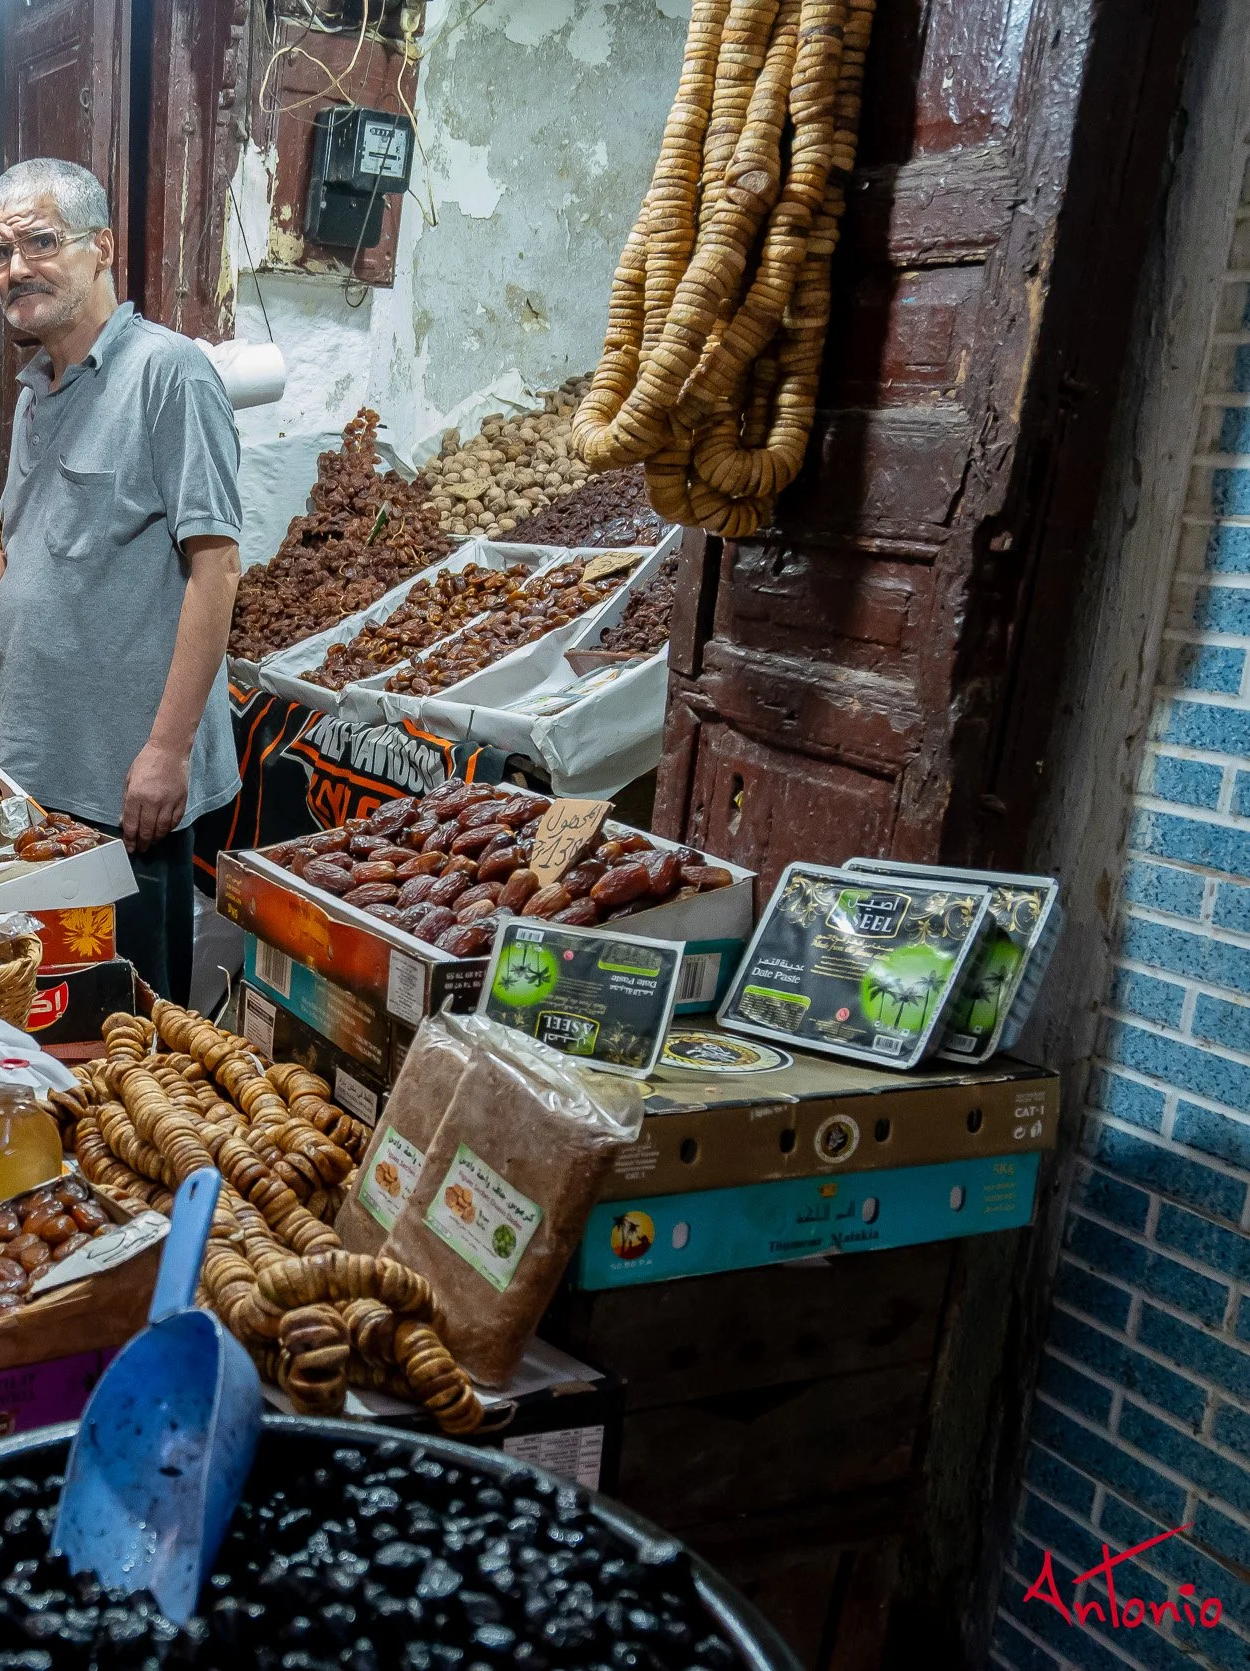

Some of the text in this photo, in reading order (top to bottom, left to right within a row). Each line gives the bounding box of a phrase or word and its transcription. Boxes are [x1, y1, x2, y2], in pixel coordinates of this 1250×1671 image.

[851, 912, 893, 933] SEEL
[610, 974, 658, 989] Date Paste
[751, 966, 801, 984] Date Paste
[543, 1014, 596, 1035] ASEEL
